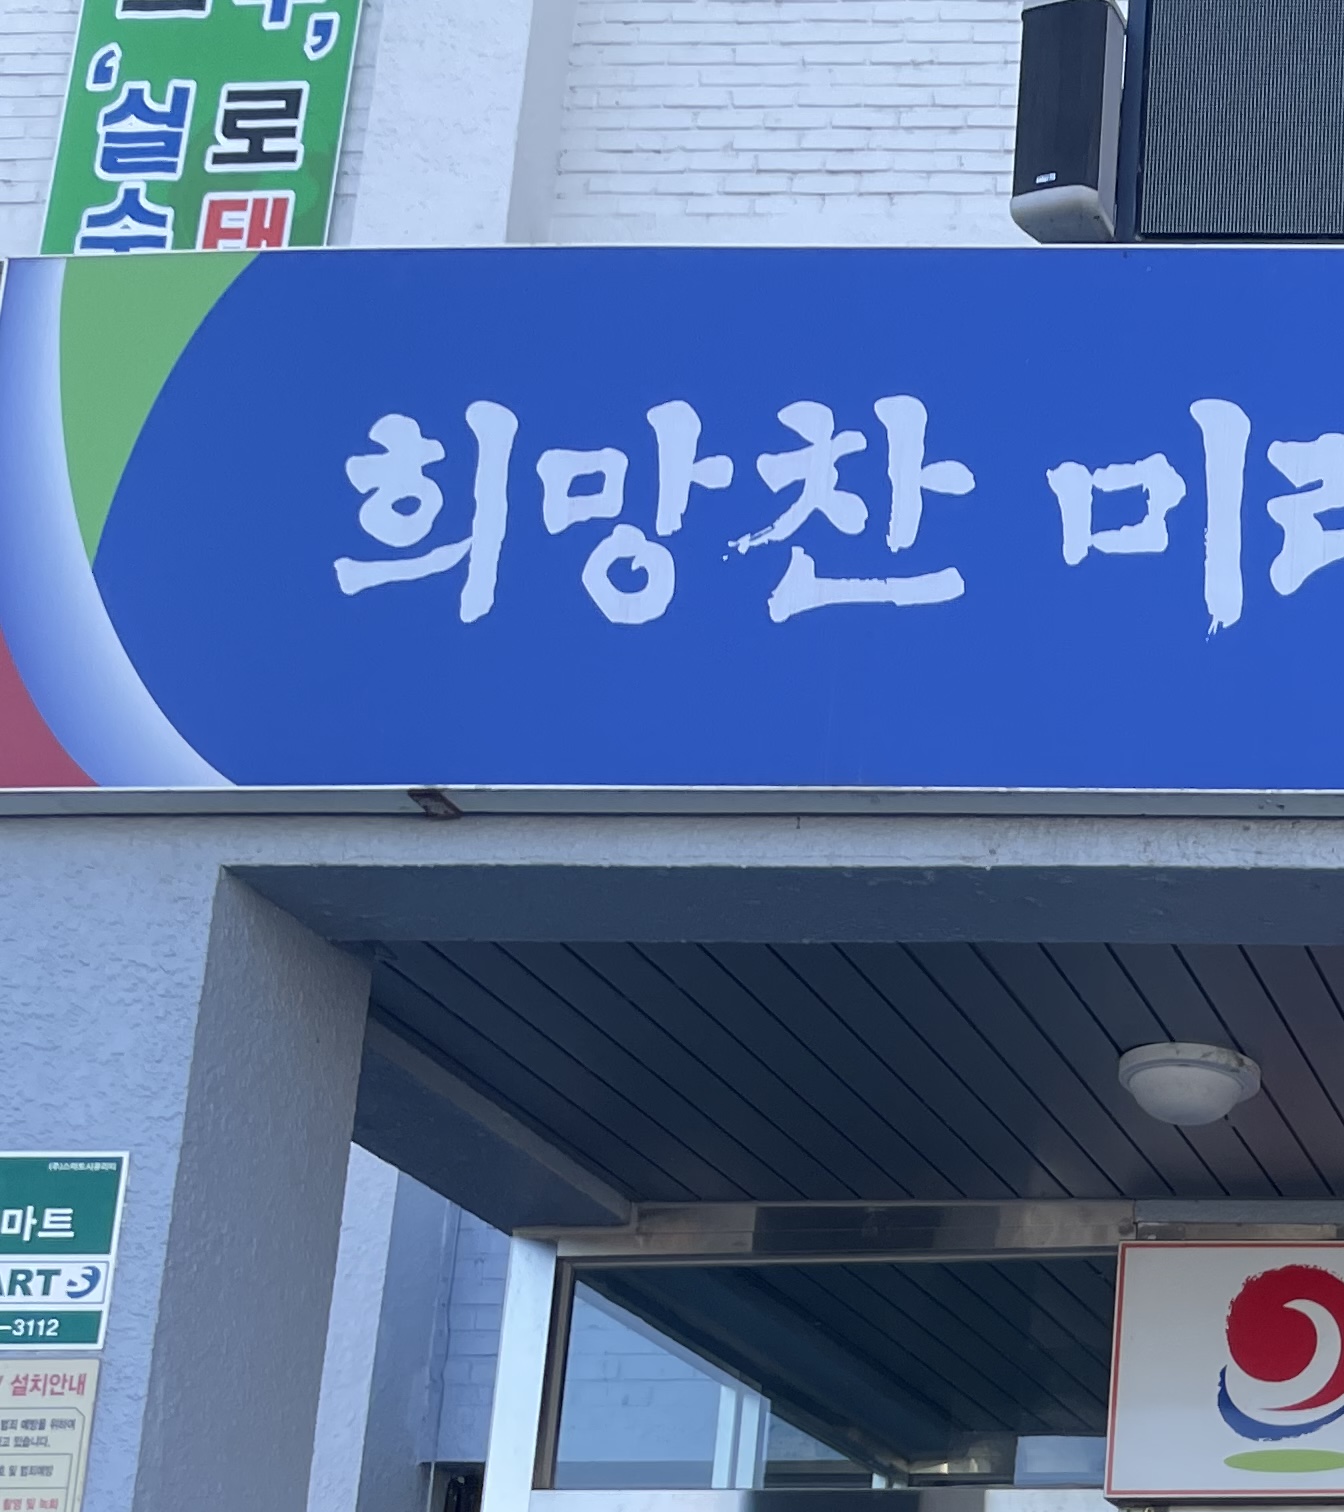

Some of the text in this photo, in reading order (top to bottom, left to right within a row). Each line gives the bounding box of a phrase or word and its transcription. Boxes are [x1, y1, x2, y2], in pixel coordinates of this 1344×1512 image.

[334, 398, 975, 623] 희망찬
[0, 1268, 62, 1297] RT
[10, 1373, 87, 1396] 설치안내
